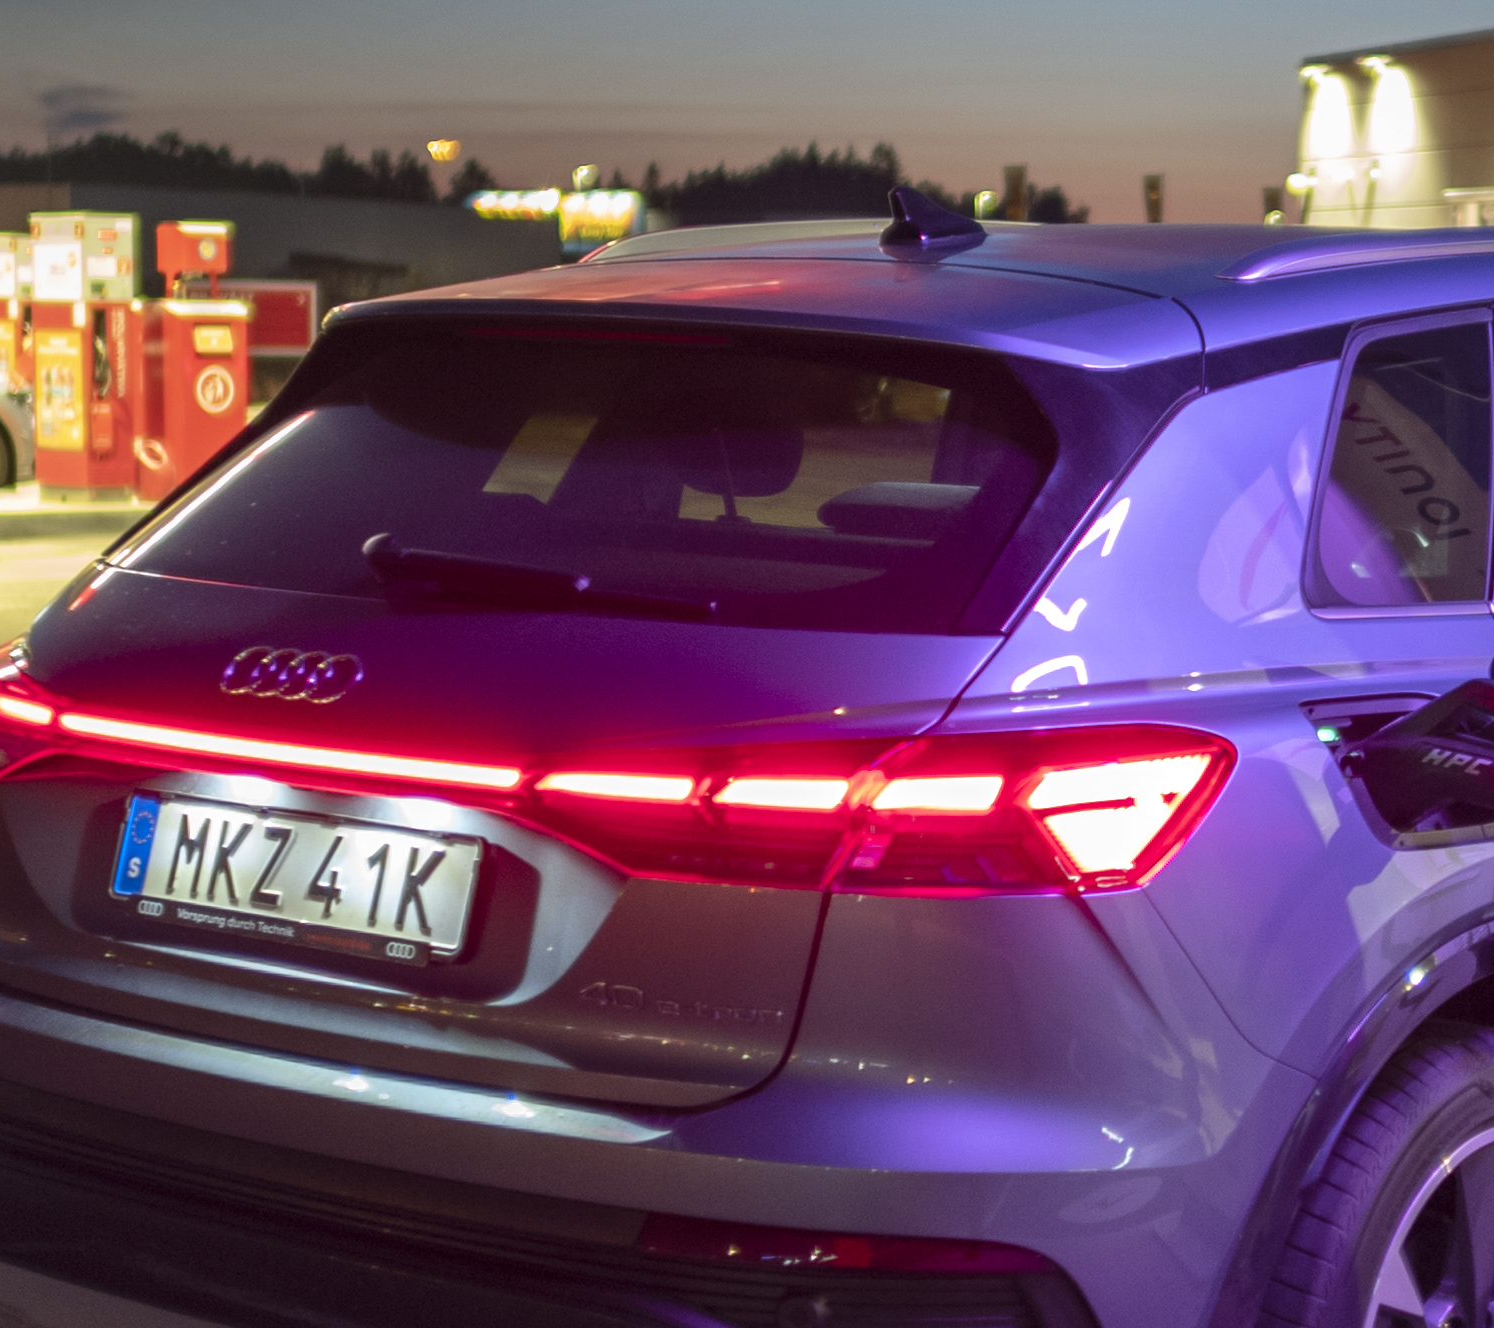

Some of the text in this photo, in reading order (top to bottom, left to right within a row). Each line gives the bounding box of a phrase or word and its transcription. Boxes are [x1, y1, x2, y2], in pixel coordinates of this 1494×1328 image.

[1421, 748, 1493, 776] HPC
[127, 856, 142, 879] S
[165, 813, 446, 937] MKZ 41K
[176, 906, 296, 939] Vorsprung durch Technik
